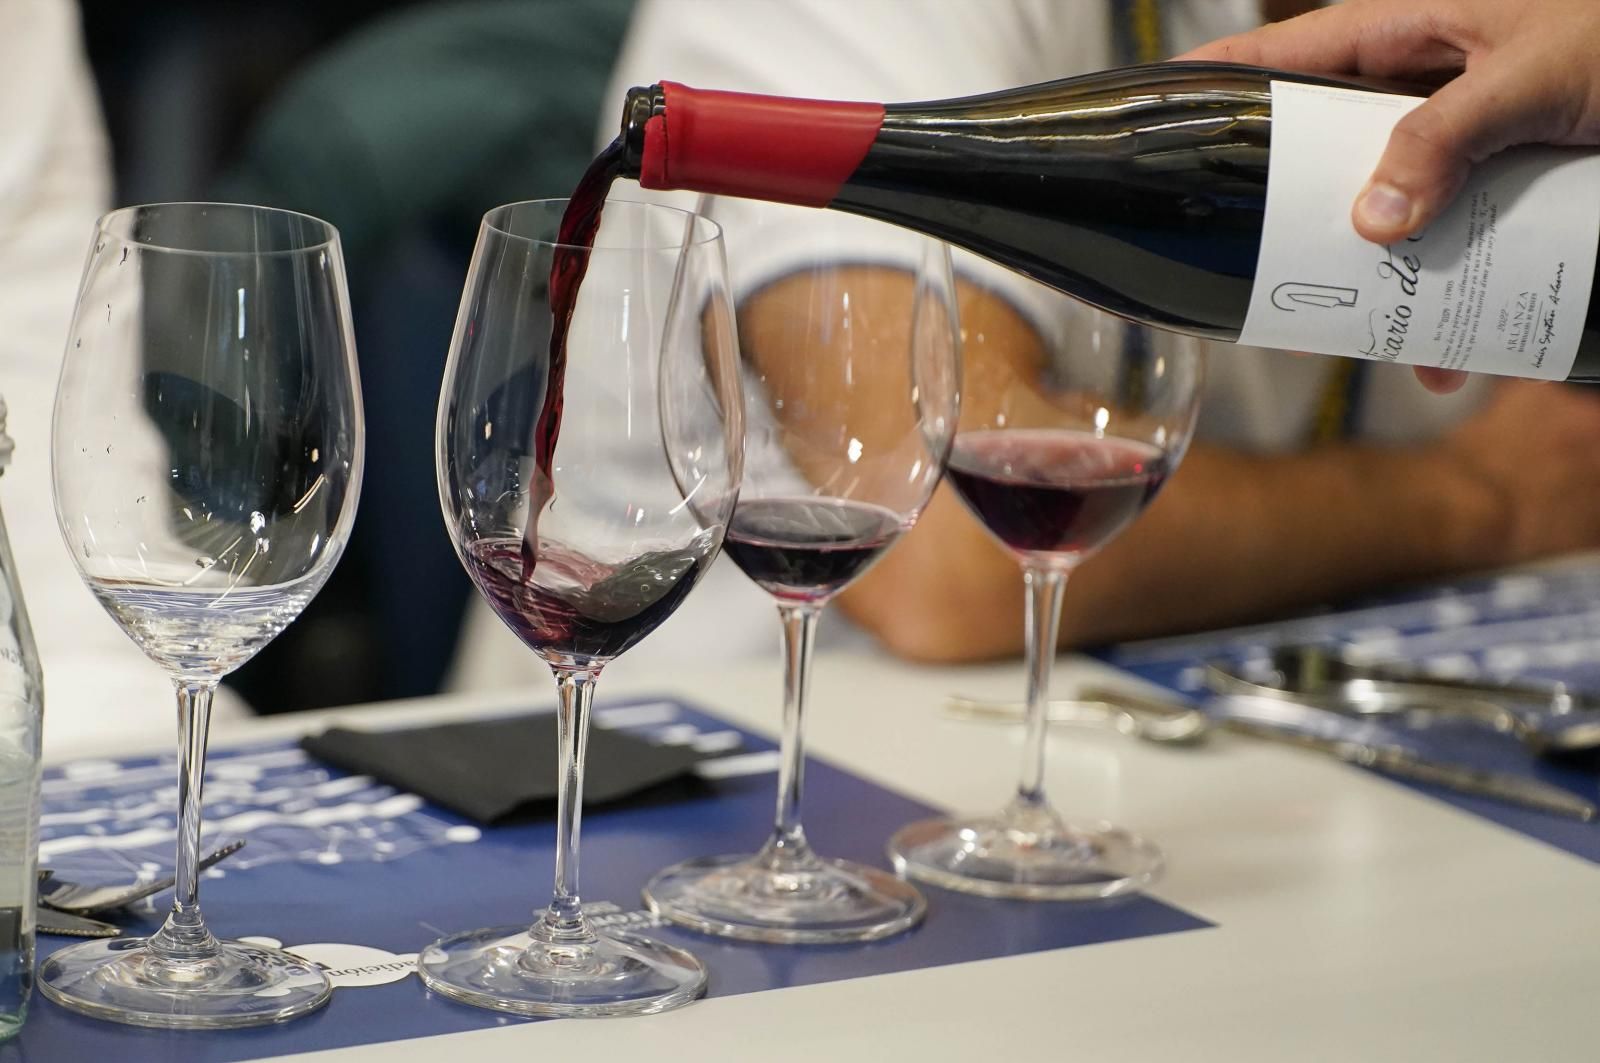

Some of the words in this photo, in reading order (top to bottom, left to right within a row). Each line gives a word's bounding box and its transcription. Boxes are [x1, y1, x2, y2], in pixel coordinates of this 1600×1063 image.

[1377, 245, 1421, 296] de
[1506, 291, 1529, 351] ARLANZA
[330, 960, 415, 977] adición
